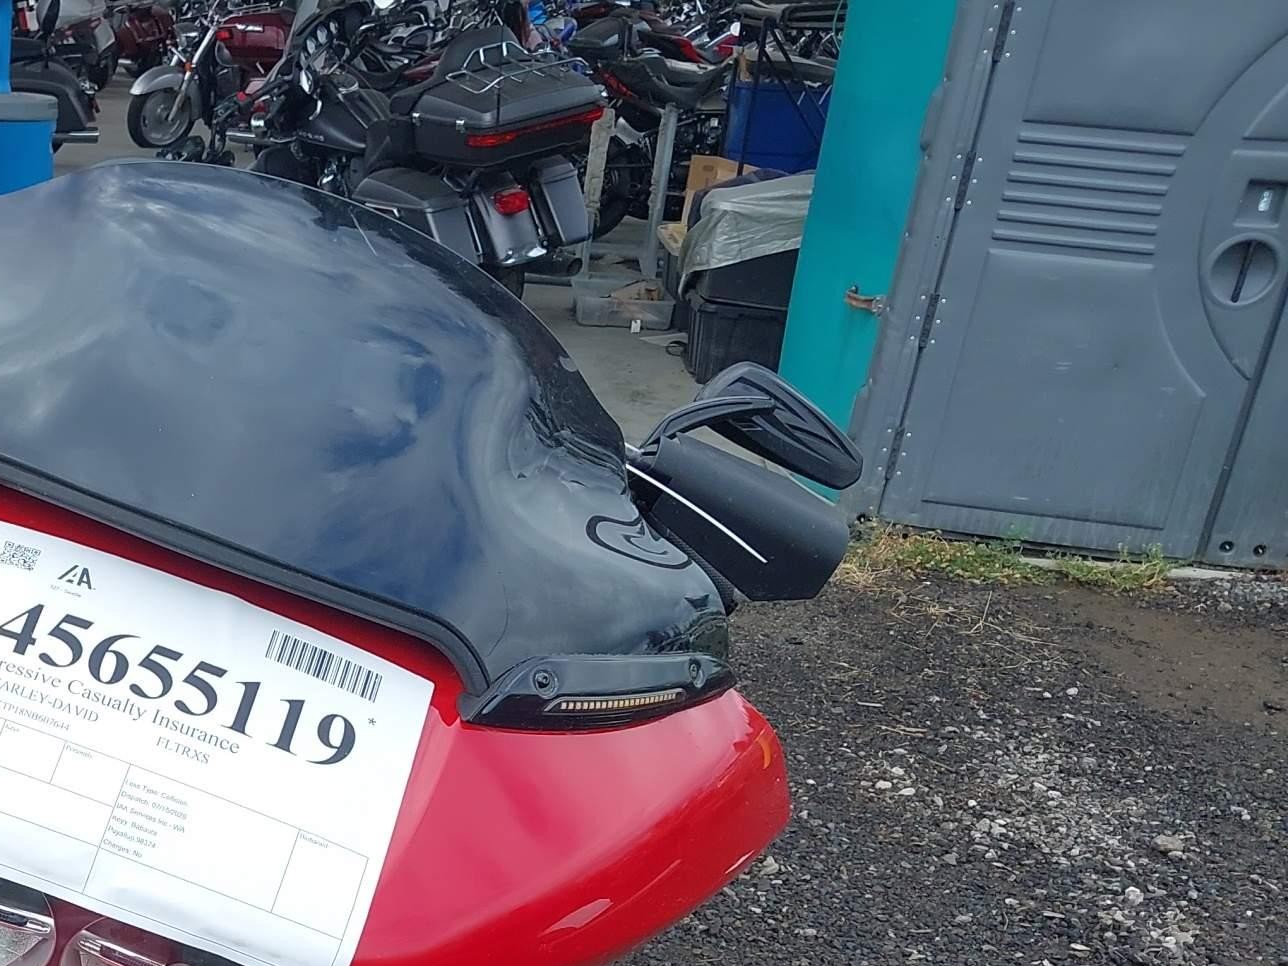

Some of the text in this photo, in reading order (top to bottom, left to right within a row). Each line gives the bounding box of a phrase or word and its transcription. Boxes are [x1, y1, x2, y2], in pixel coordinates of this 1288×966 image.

[67, 679, 148, 721] Casualty
[152, 709, 240, 754] Insurance
[156, 736, 211, 764] FLTRXS
